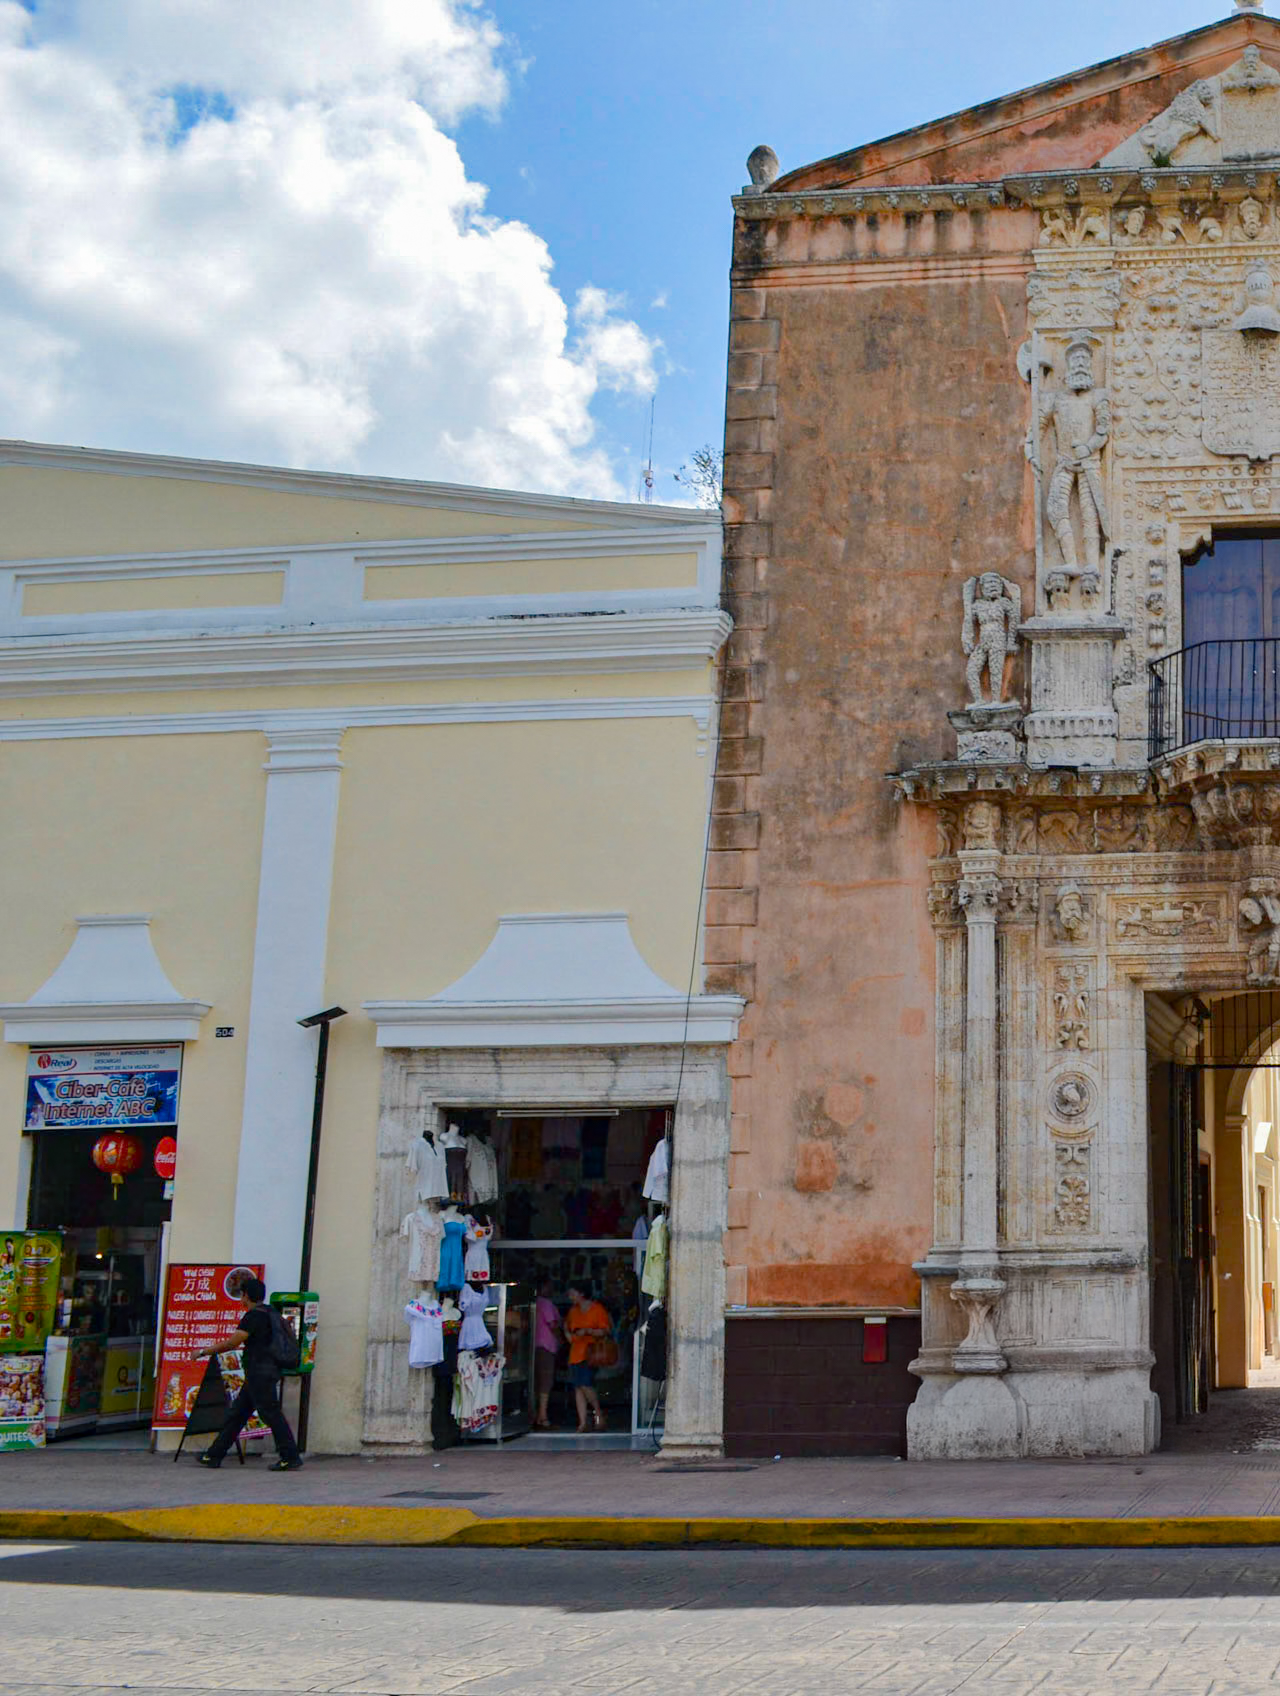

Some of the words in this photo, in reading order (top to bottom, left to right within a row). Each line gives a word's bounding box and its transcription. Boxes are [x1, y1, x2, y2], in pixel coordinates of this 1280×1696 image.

[50, 1057, 73, 1068] Real
[56, 1078, 147, 1099] Ciber-Café
[44, 1101, 113, 1120] Internet
[115, 1099, 156, 1118] ABC
